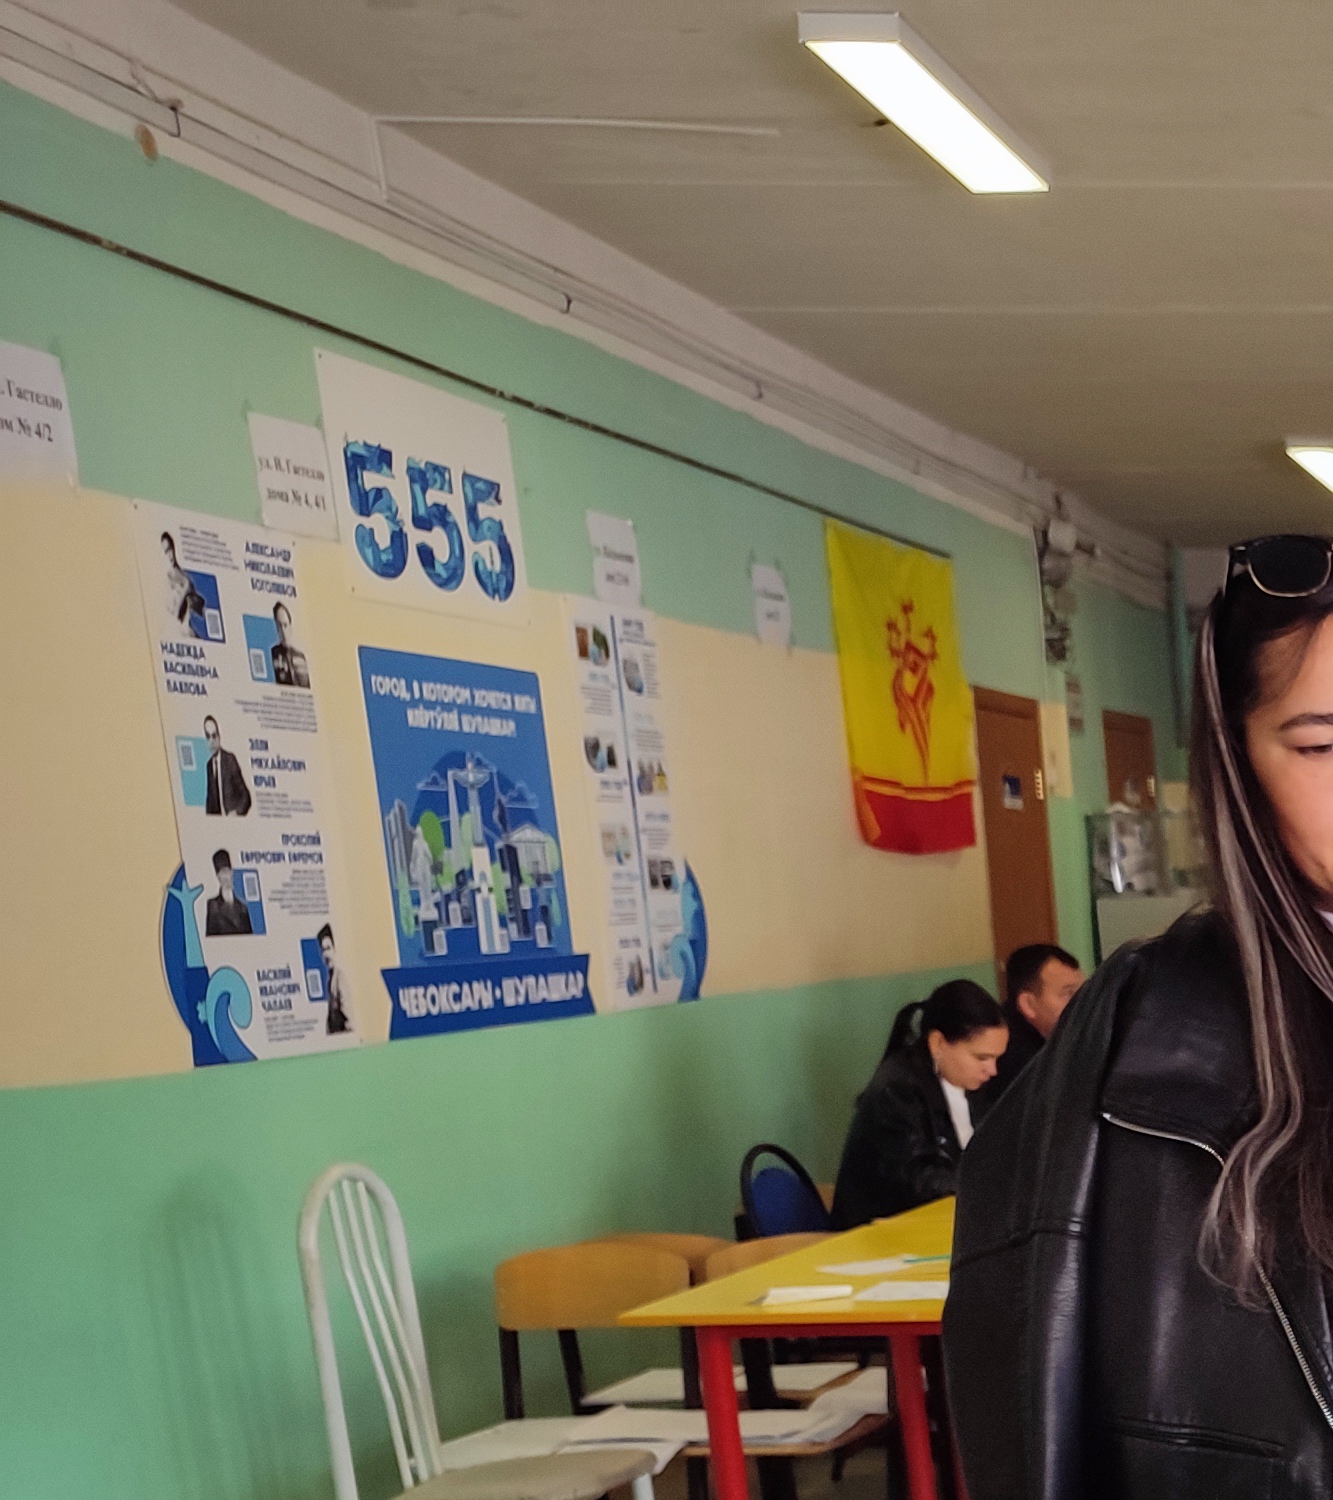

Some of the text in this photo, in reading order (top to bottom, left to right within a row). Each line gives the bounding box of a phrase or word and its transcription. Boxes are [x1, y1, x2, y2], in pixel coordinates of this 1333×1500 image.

[342, 438, 516, 603] 555
[399, 978, 495, 1018] ЧЕБОКСАРЫ
[501, 970, 585, 1008] ШУПАШКАР
